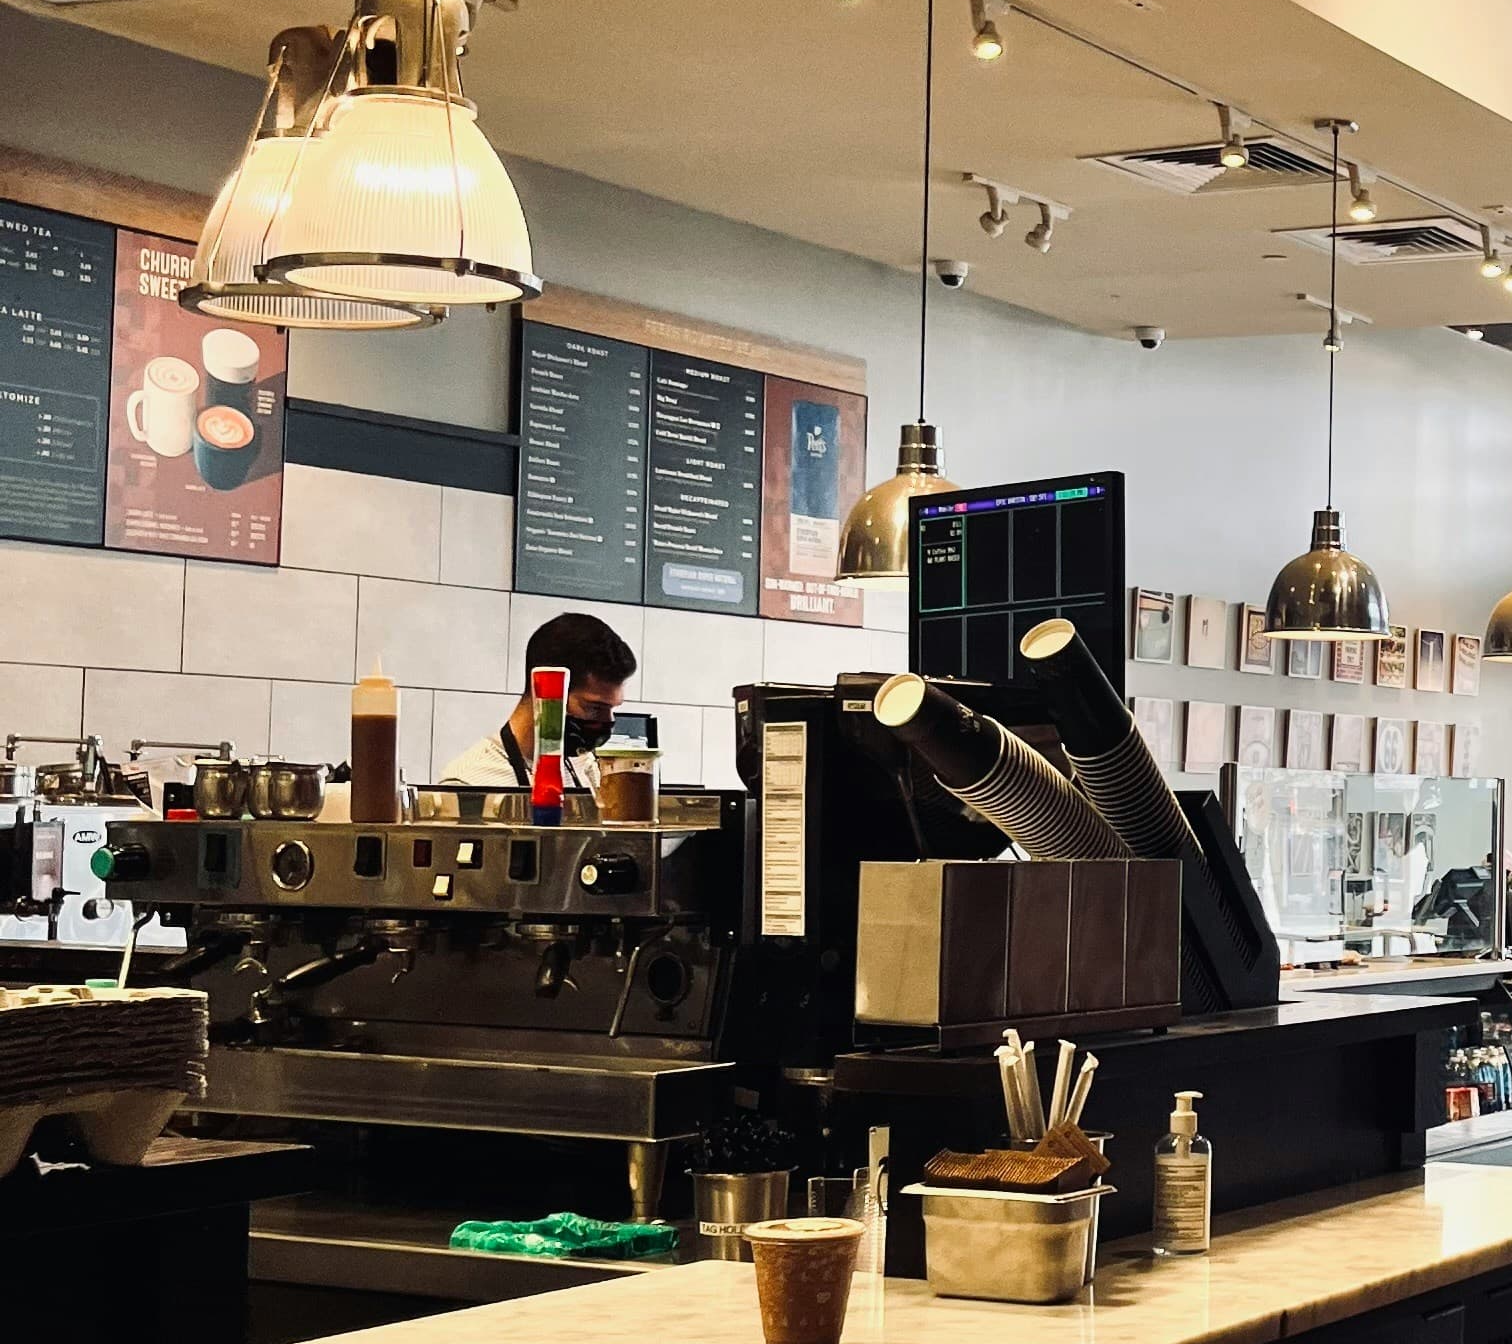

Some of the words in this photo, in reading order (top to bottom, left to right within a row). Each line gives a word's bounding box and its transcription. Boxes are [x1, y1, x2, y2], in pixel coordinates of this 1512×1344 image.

[32, 226, 52, 238] TEA
[11, 308, 42, 322] LATTE
[702, 1223, 718, 1234] TAG
